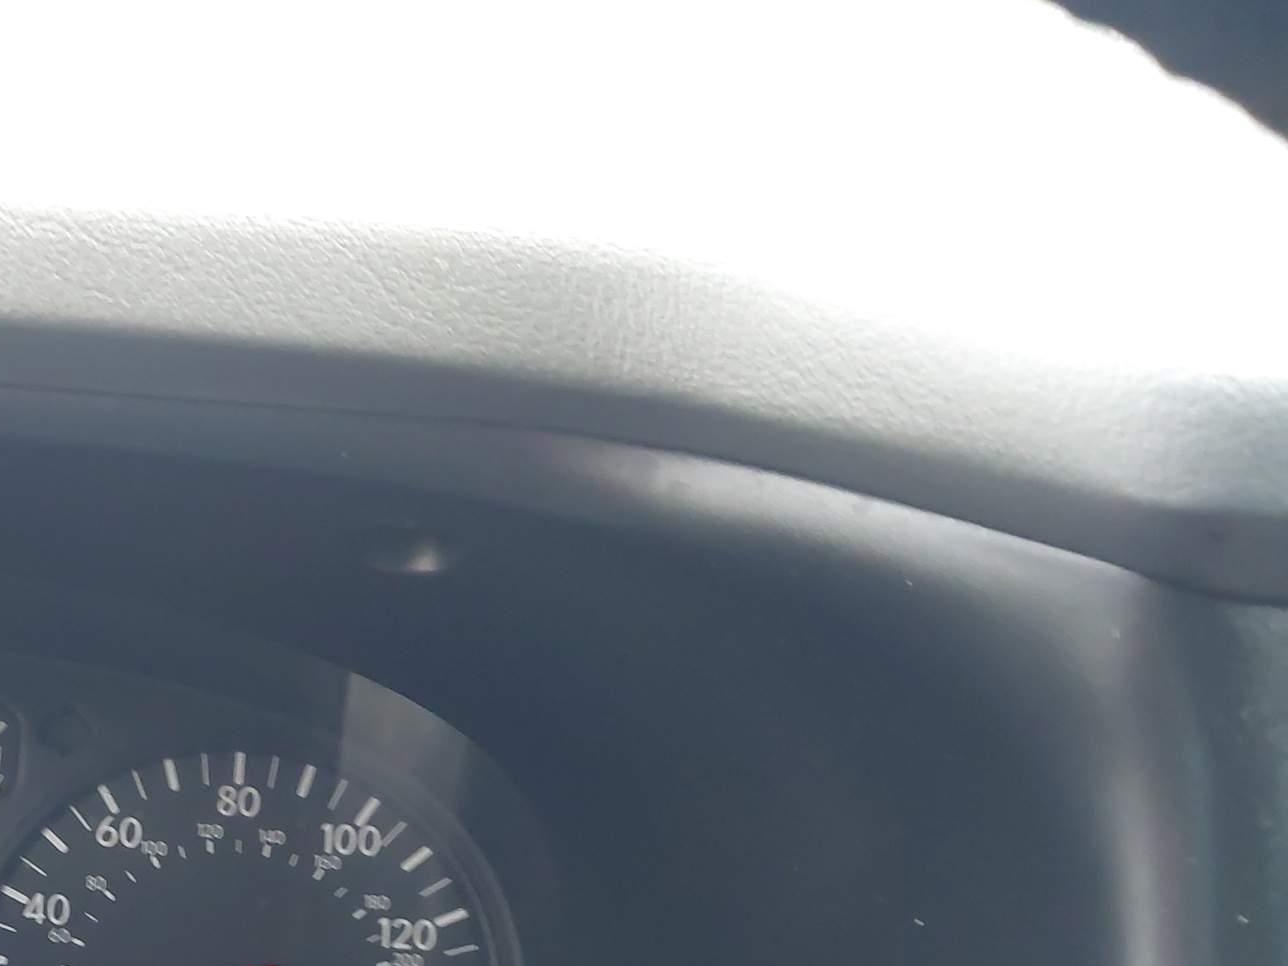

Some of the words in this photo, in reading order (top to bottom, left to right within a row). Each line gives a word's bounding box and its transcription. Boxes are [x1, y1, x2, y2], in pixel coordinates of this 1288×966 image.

[217, 786, 260, 817] 80
[95, 816, 142, 848] 60
[321, 823, 381, 856] 100
[22, 893, 70, 926] 40
[377, 917, 437, 951] 120
